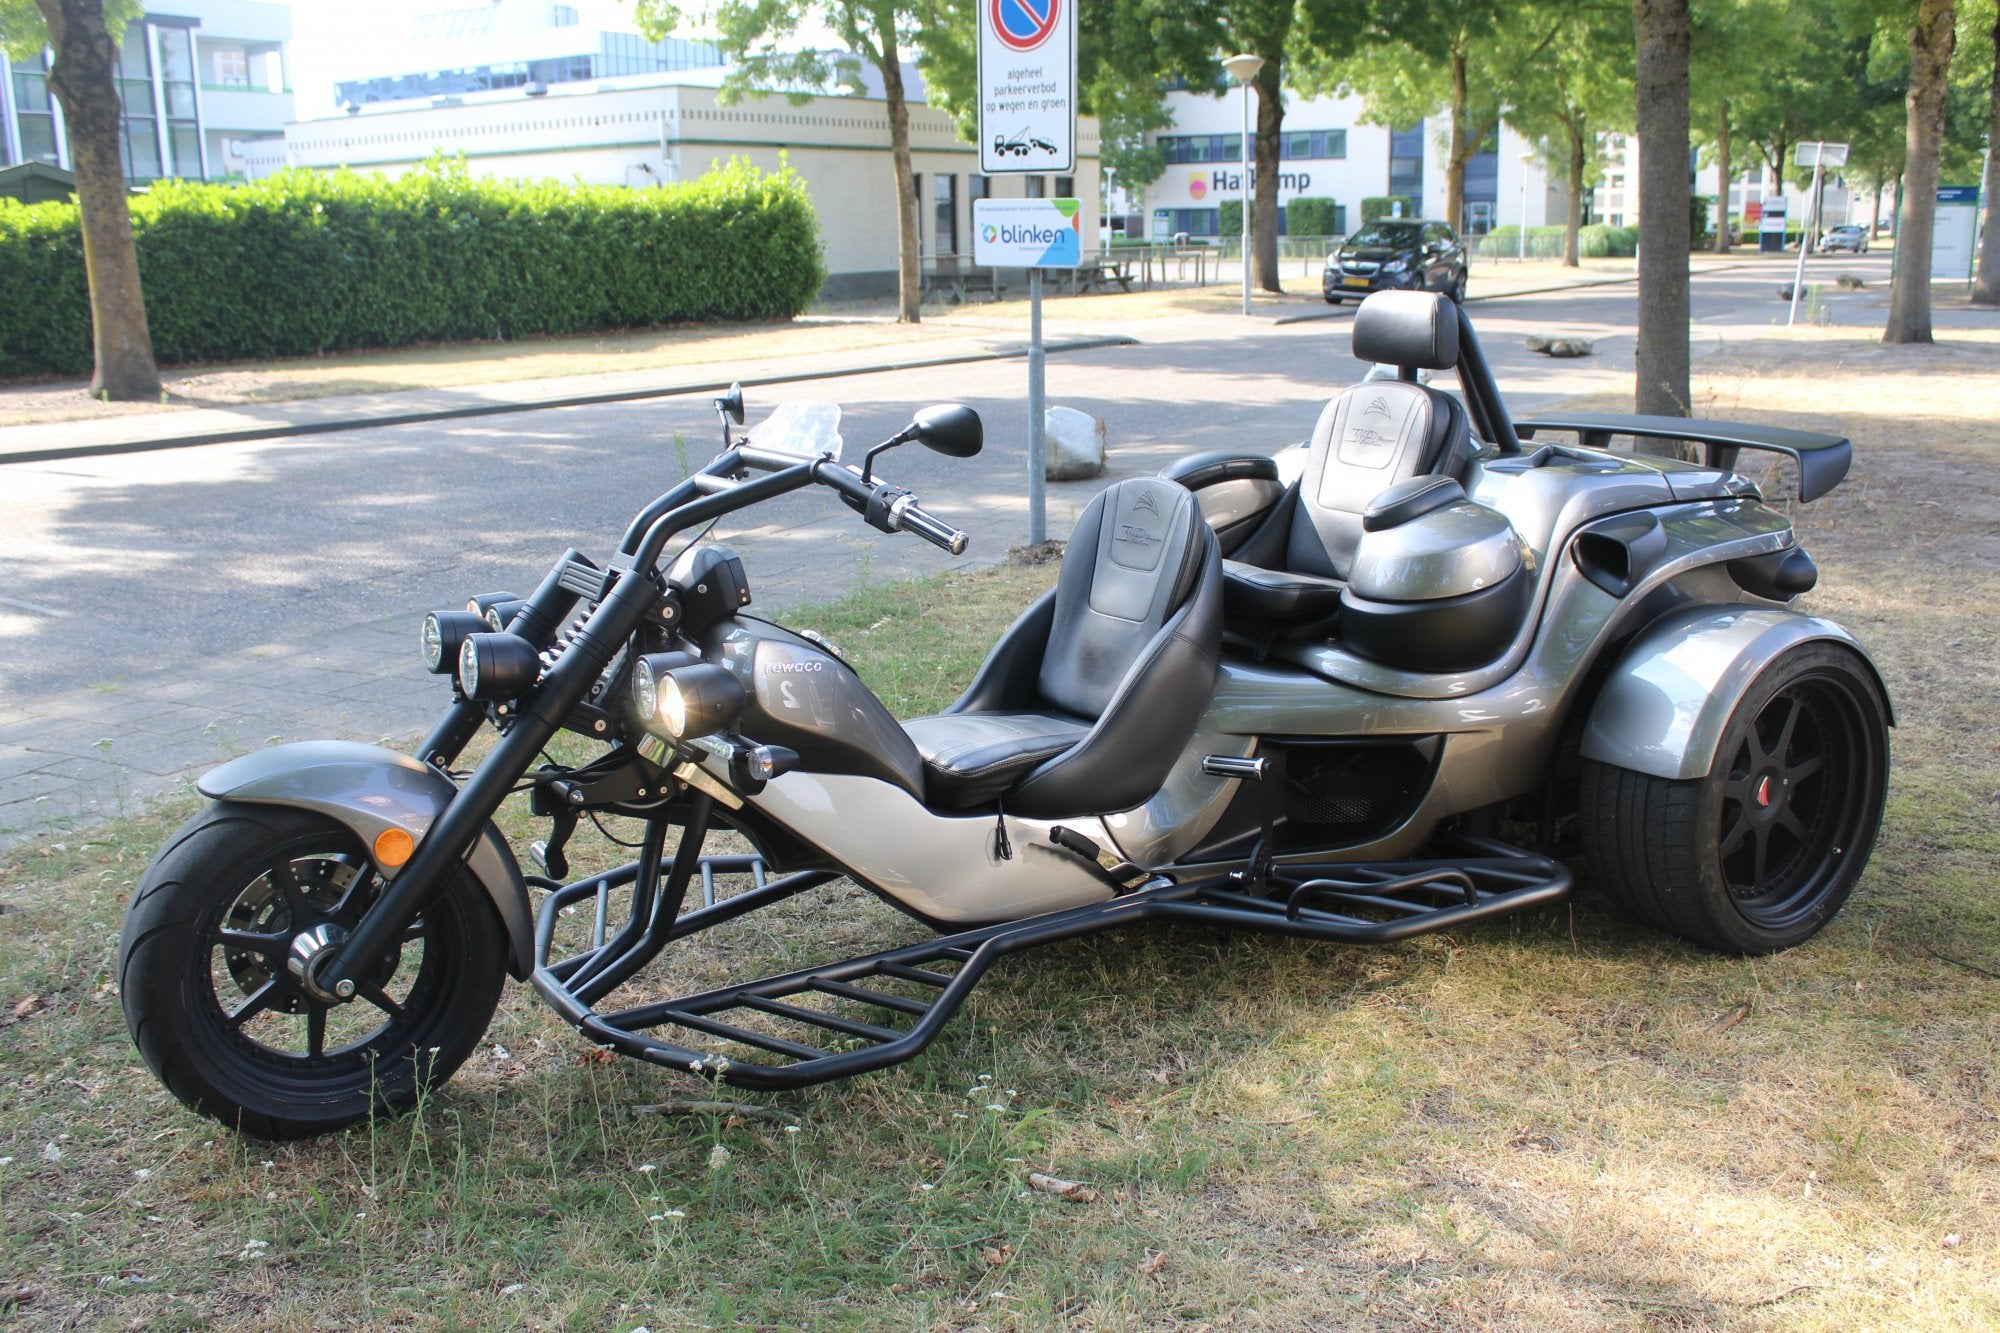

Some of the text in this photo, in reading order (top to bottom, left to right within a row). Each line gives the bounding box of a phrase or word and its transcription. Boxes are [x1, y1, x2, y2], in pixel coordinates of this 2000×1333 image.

[1007, 67, 1042, 81] algeheel
[994, 82, 1056, 97] parkeerverbod
[986, 99, 1066, 113] op wegen en groen
[1001, 224, 1065, 244] blinken
[765, 661, 822, 674] rewaco
